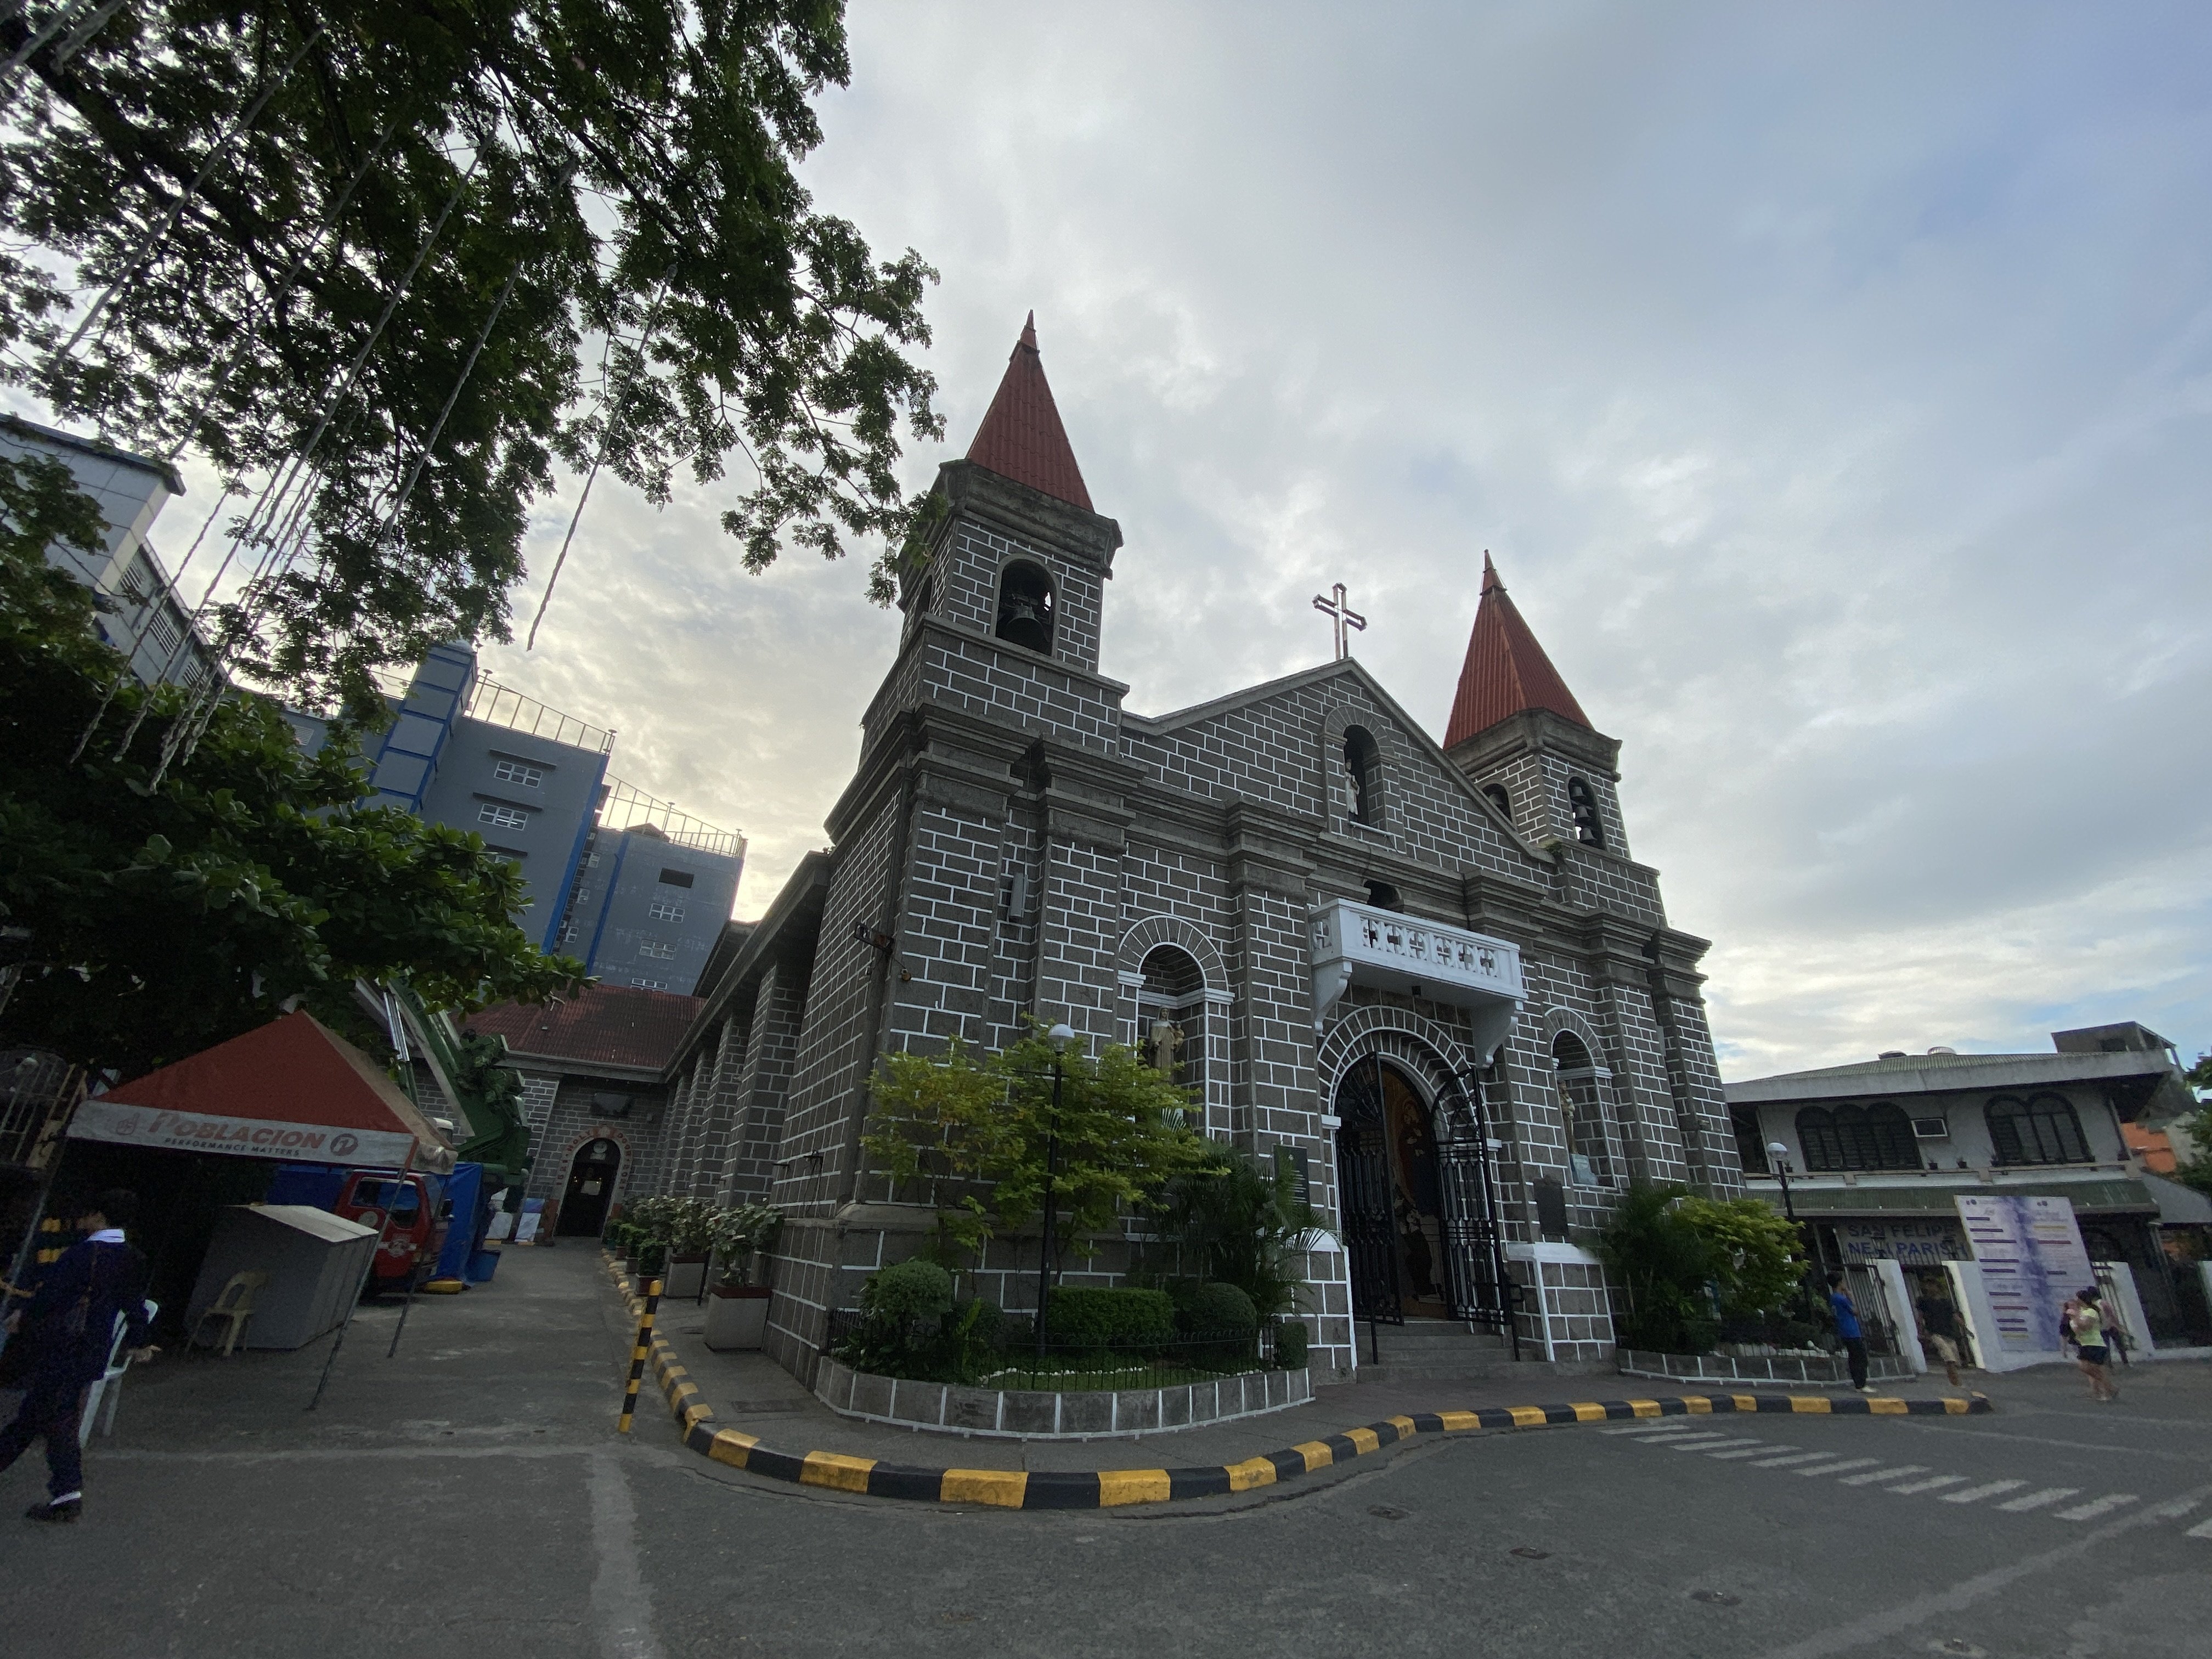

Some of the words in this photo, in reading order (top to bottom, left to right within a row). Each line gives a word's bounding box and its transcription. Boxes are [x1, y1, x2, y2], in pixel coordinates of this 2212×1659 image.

[148, 1112, 327, 1149] POBLACION
[165, 1137, 246, 1152] PERFORMANCE
[251, 1146, 299, 1156] MATTERS
[566, 1130, 590, 1151] HOLY
[617, 1133, 631, 1156] DOOR
[1891, 1224, 1955, 1238] FELIPE
[1896, 1242, 1968, 1257] PARISH
